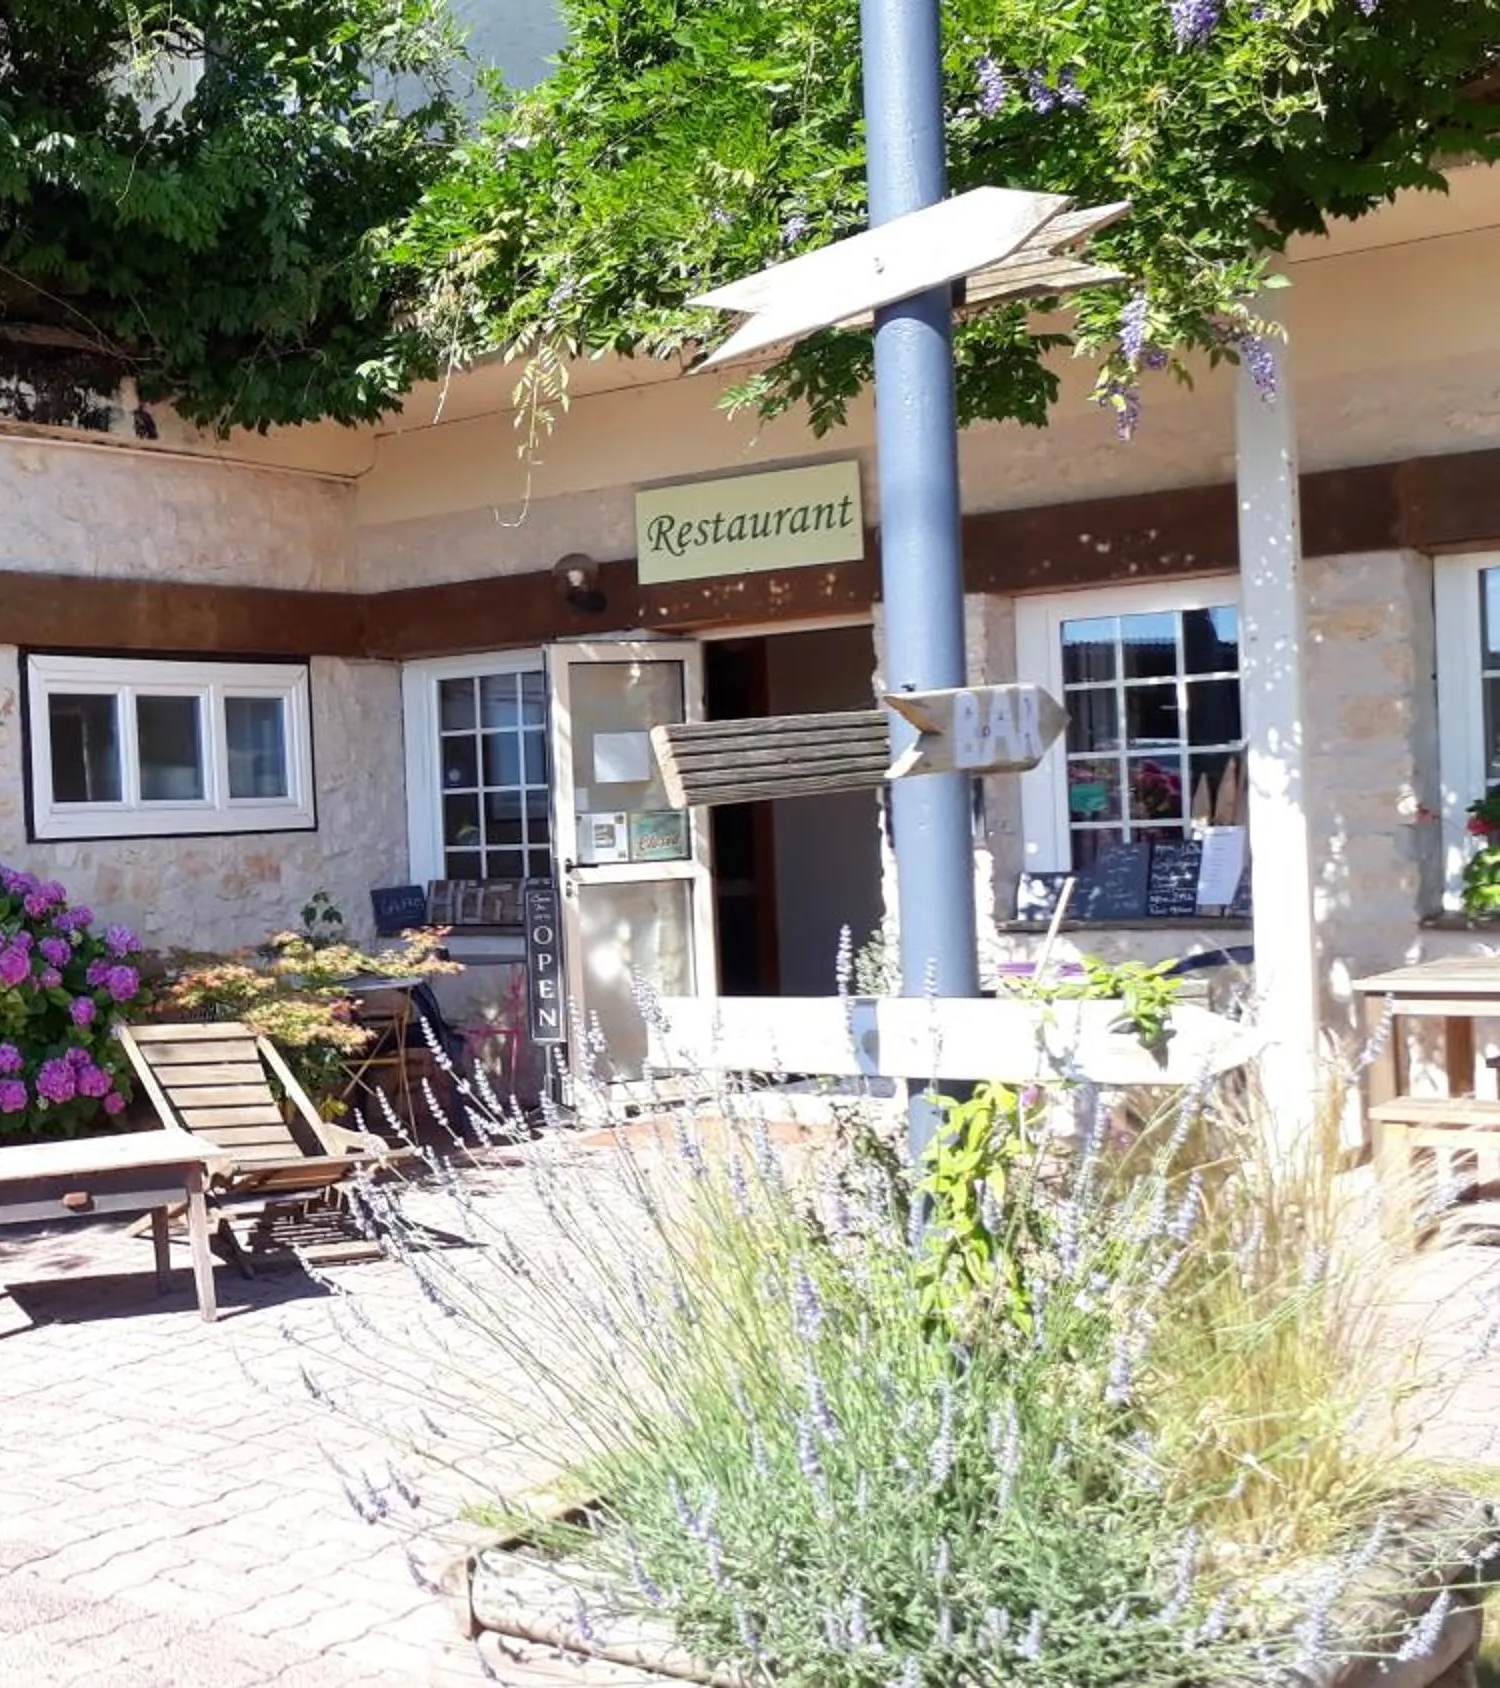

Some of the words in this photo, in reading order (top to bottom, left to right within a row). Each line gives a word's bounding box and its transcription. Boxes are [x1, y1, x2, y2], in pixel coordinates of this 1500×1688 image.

[647, 495, 853, 557] Restaurant
[954, 684, 1045, 769] BAR
[533, 925, 557, 1028] OPEN
